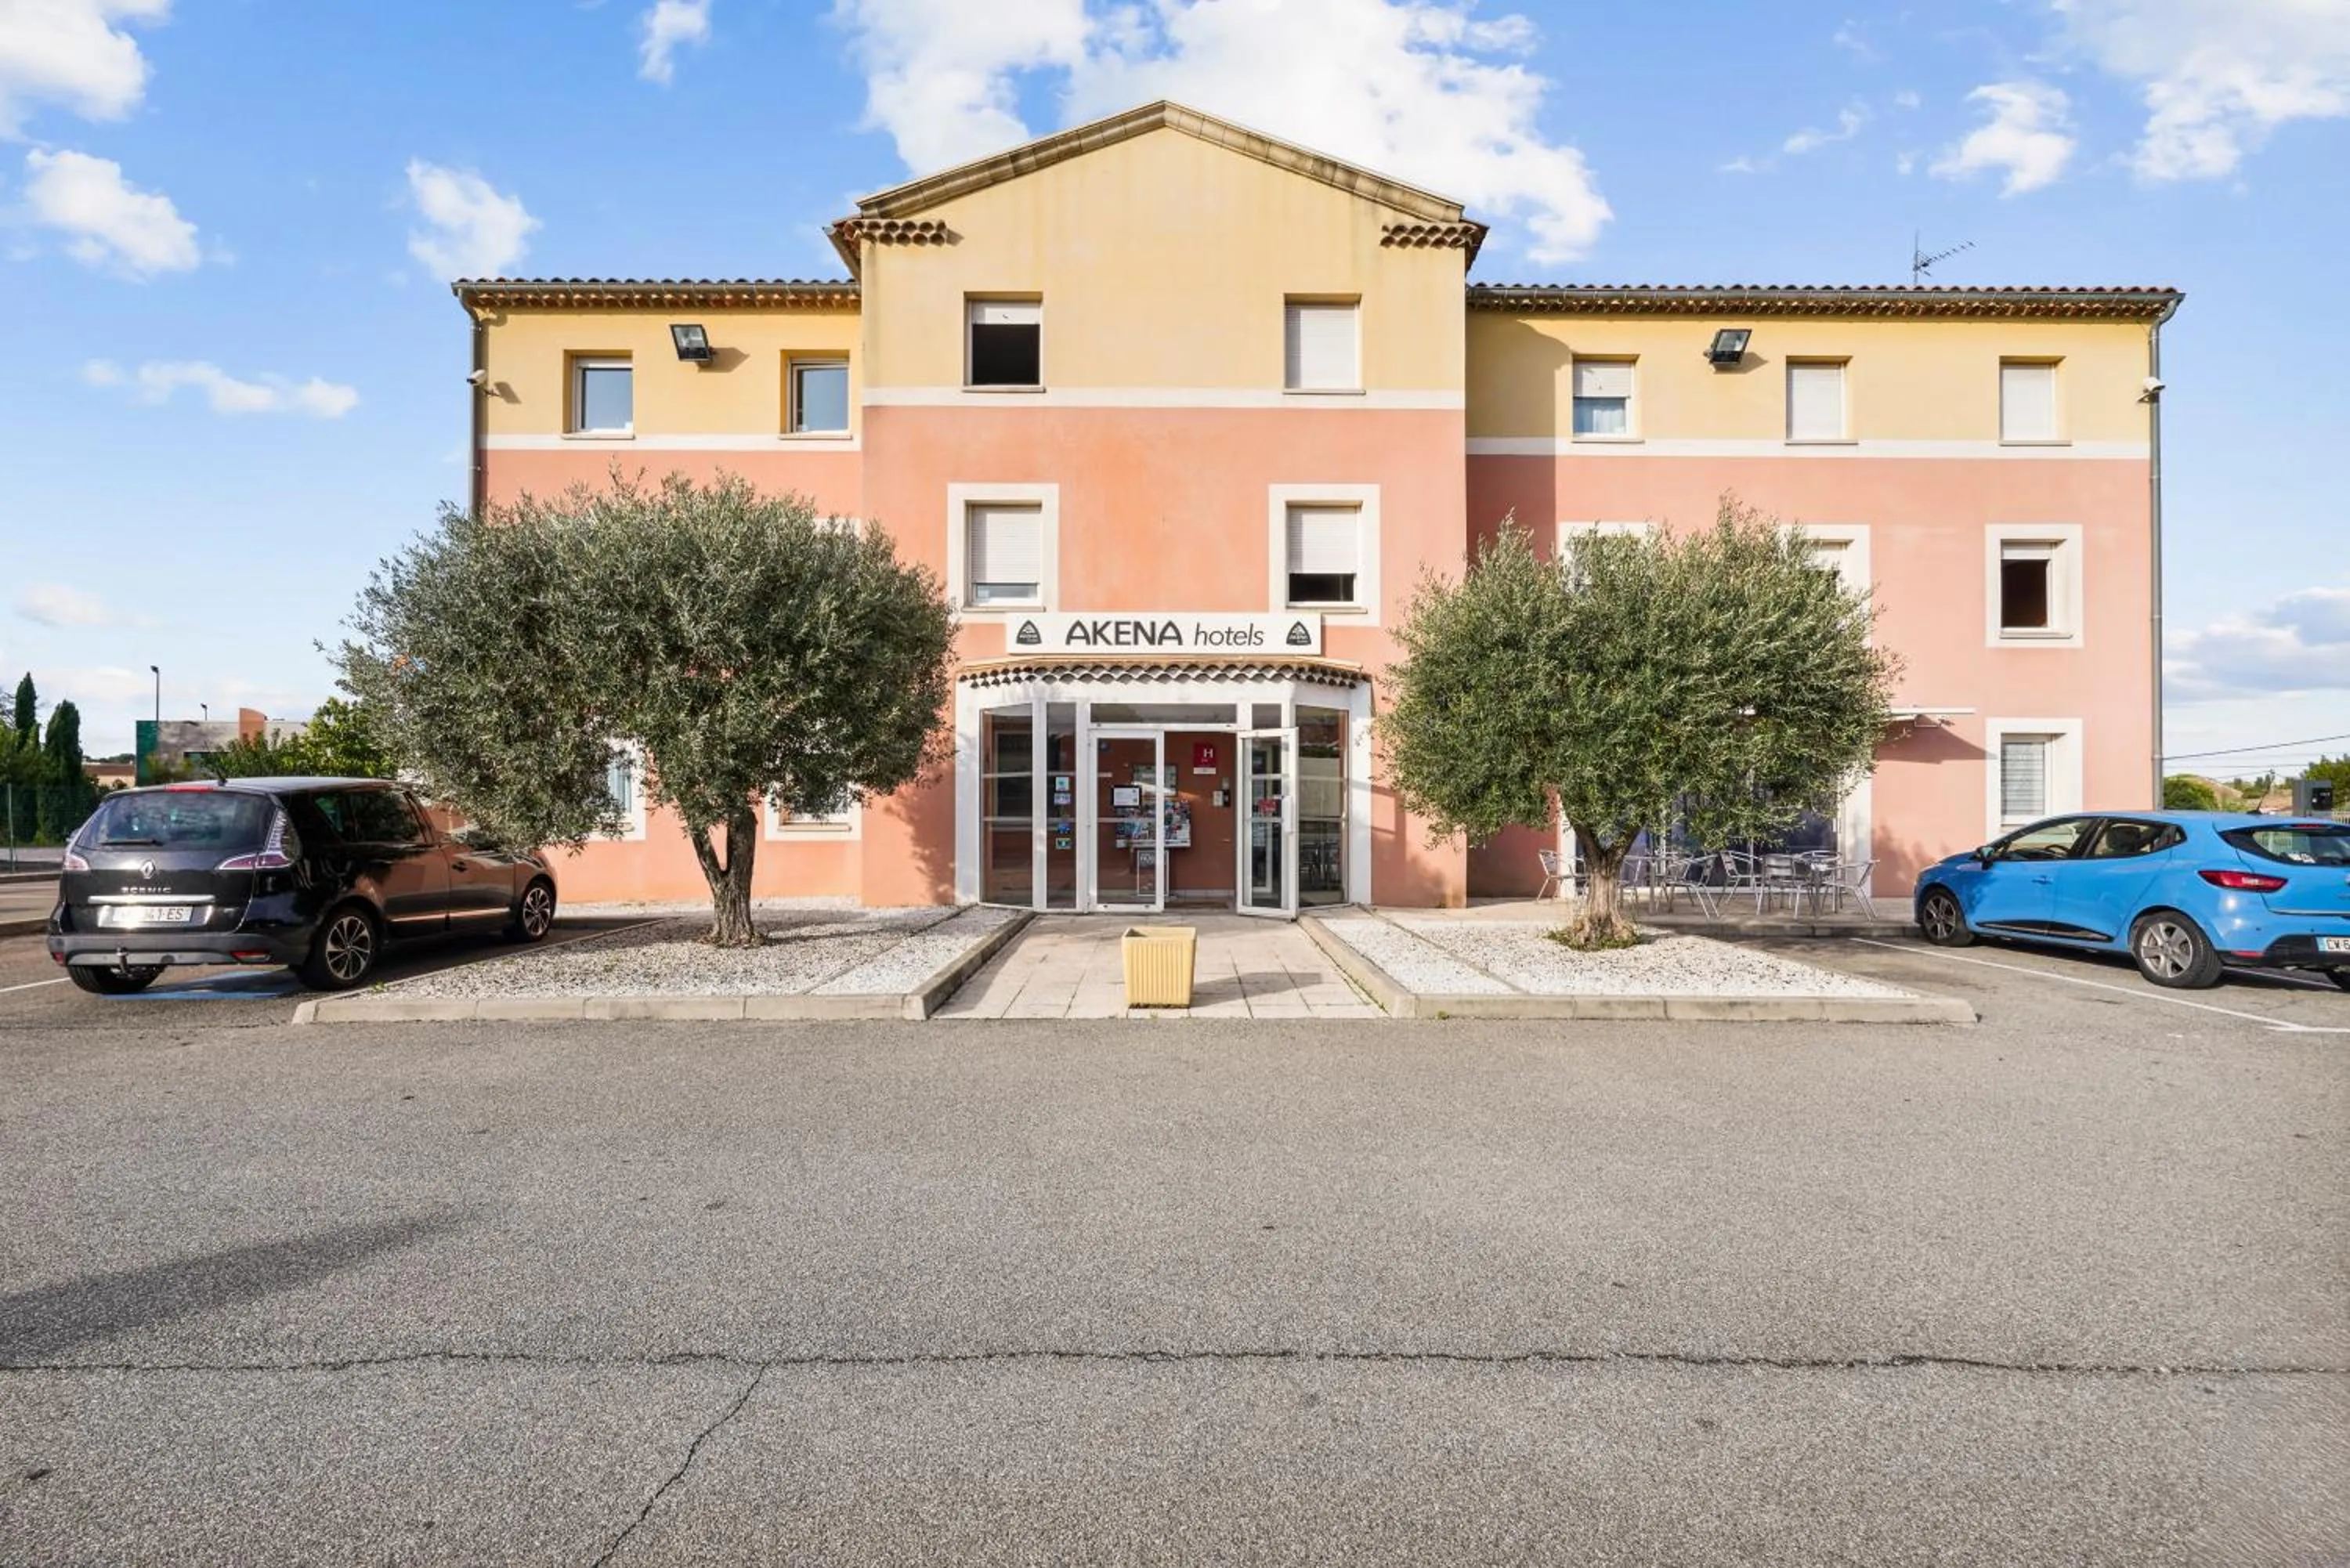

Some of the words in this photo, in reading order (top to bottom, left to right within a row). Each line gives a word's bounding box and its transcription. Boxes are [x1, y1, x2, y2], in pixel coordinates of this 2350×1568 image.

[1065, 620, 1184, 645] AKENA
[1194, 623, 1265, 645] hotels
[1203, 748, 1213, 758] H
